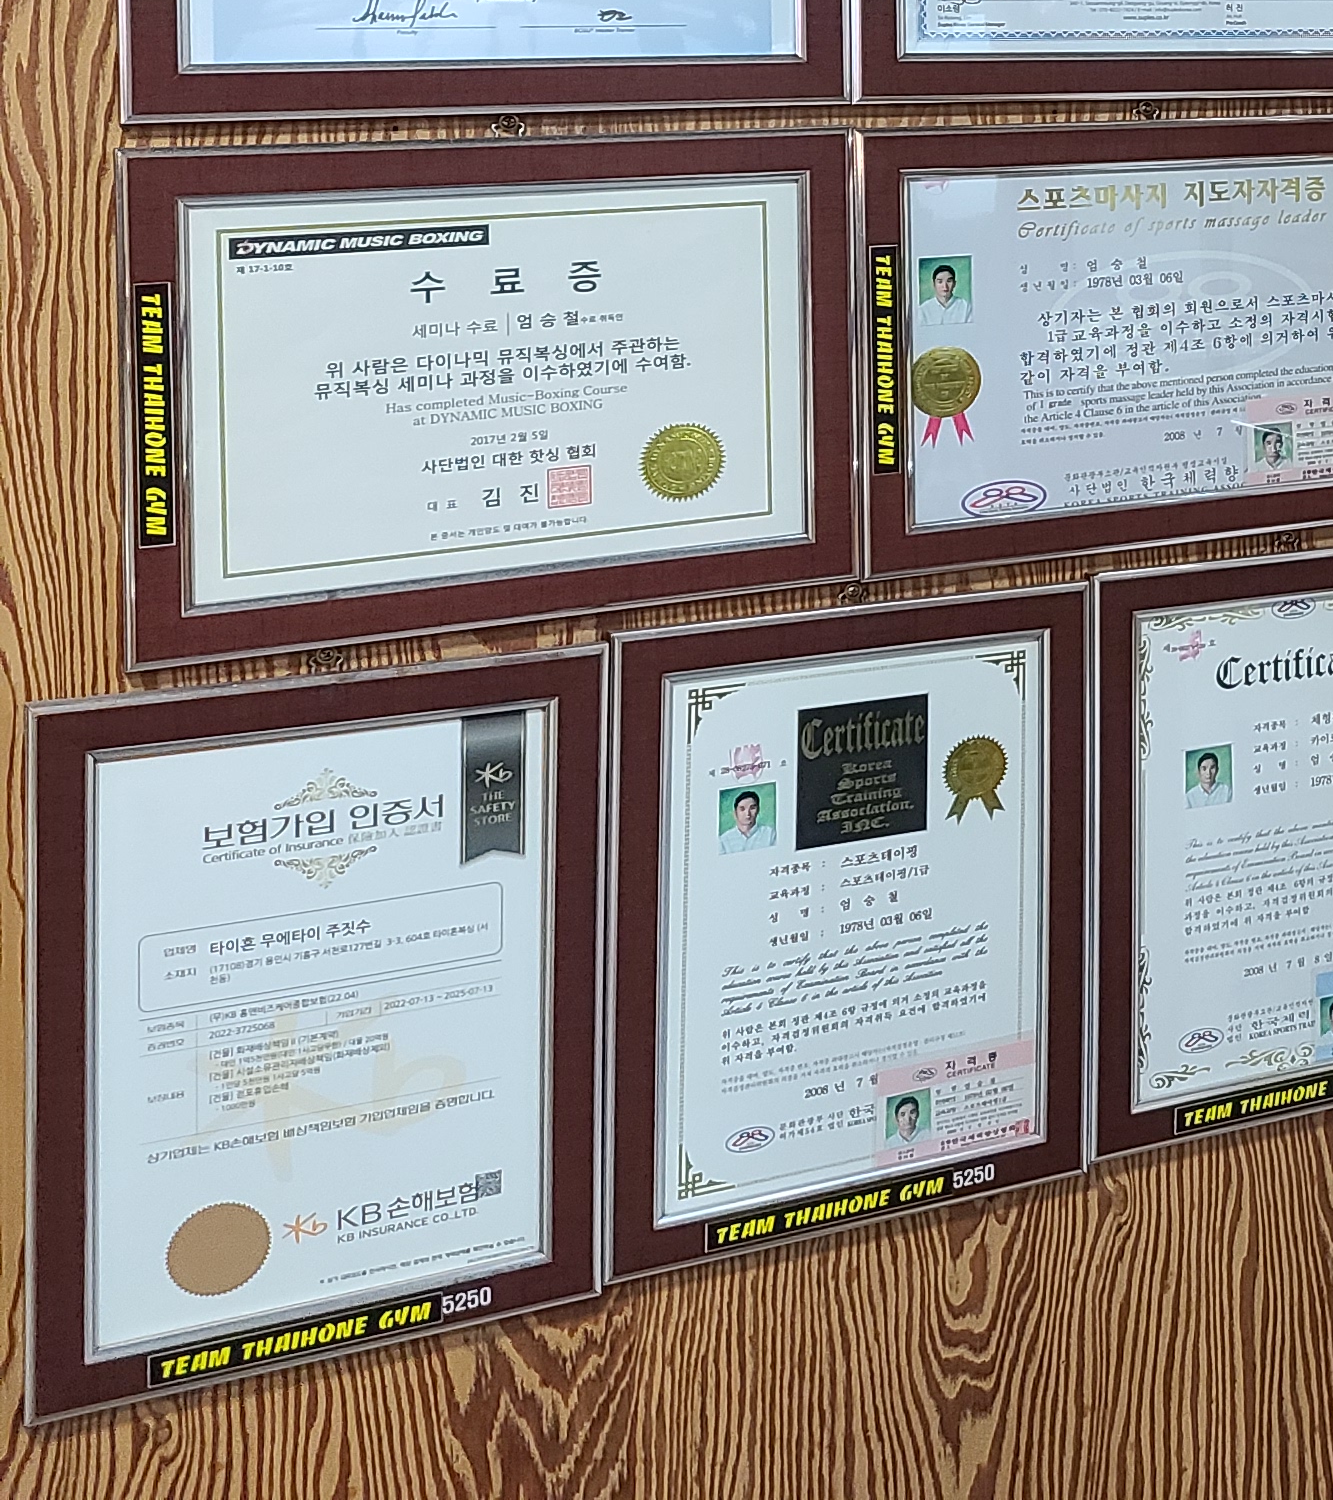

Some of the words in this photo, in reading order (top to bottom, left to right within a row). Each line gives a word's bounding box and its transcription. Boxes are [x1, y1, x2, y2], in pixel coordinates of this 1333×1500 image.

[1016, 182, 1166, 211] 스포츠마사지
[1183, 176, 1326, 207] 지도자자격증
[235, 238, 337, 255] DYNAMIC
[338, 234, 404, 251] MUSIC
[408, 230, 486, 250] BOXING
[1017, 220, 1115, 240] Certificate
[1124, 218, 1143, 237] of
[1147, 217, 1196, 233] sports
[1204, 215, 1269, 231] massage
[1277, 210, 1327, 226] leader
[875, 255, 892, 307] TEAM
[140, 293, 163, 354] TEAM
[411, 321, 460, 338] 세미나
[465, 319, 498, 335] 수료
[325, 361, 343, 379] 위
[351, 357, 408, 376] 사람은
[416, 349, 488, 371] 다이나믹
[496, 340, 603, 365] 뮤직복싱에서
[610, 336, 680, 356] 주관하는
[876, 315, 894, 413] THAIHONE
[313, 377, 389, 400] 뮤직복싱
[397, 372, 453, 392] 세미나
[459, 367, 515, 387] 과정을
[522, 358, 627, 382] 이수하였기에
[142, 363, 166, 477] THAIHONE
[421, 454, 485, 474] 사단법인
[492, 450, 523, 467] 대한
[565, 443, 596, 460] 협회
[877, 423, 894, 464] GYM
[145, 486, 167, 535] GYM
[801, 710, 926, 761] Certificate
[202, 808, 334, 850] 보험가입
[349, 793, 444, 830] 인증서
[469, 801, 516, 814] SAFETY
[474, 812, 513, 827] STORE
[202, 848, 266, 864] Certificate
[268, 843, 282, 855] of
[284, 837, 344, 852] Insurance
[325, 918, 371, 938] 주짓수
[1184, 1102, 1233, 1125] TEAM
[1240, 1081, 1327, 1112] THAIHONE
[952, 1163, 995, 1190] 5250
[336, 1232, 355, 1244] KB
[358, 1216, 428, 1239] INSURANCE
[717, 1214, 775, 1243] TEAM
[784, 1188, 890, 1228] THAIHONE
[899, 1176, 944, 1201] GYM
[441, 1287, 493, 1315] 5250
[161, 1345, 231, 1378] TEAM
[242, 1315, 368, 1360] THAIHONE
[378, 1301, 431, 1329] GYM
